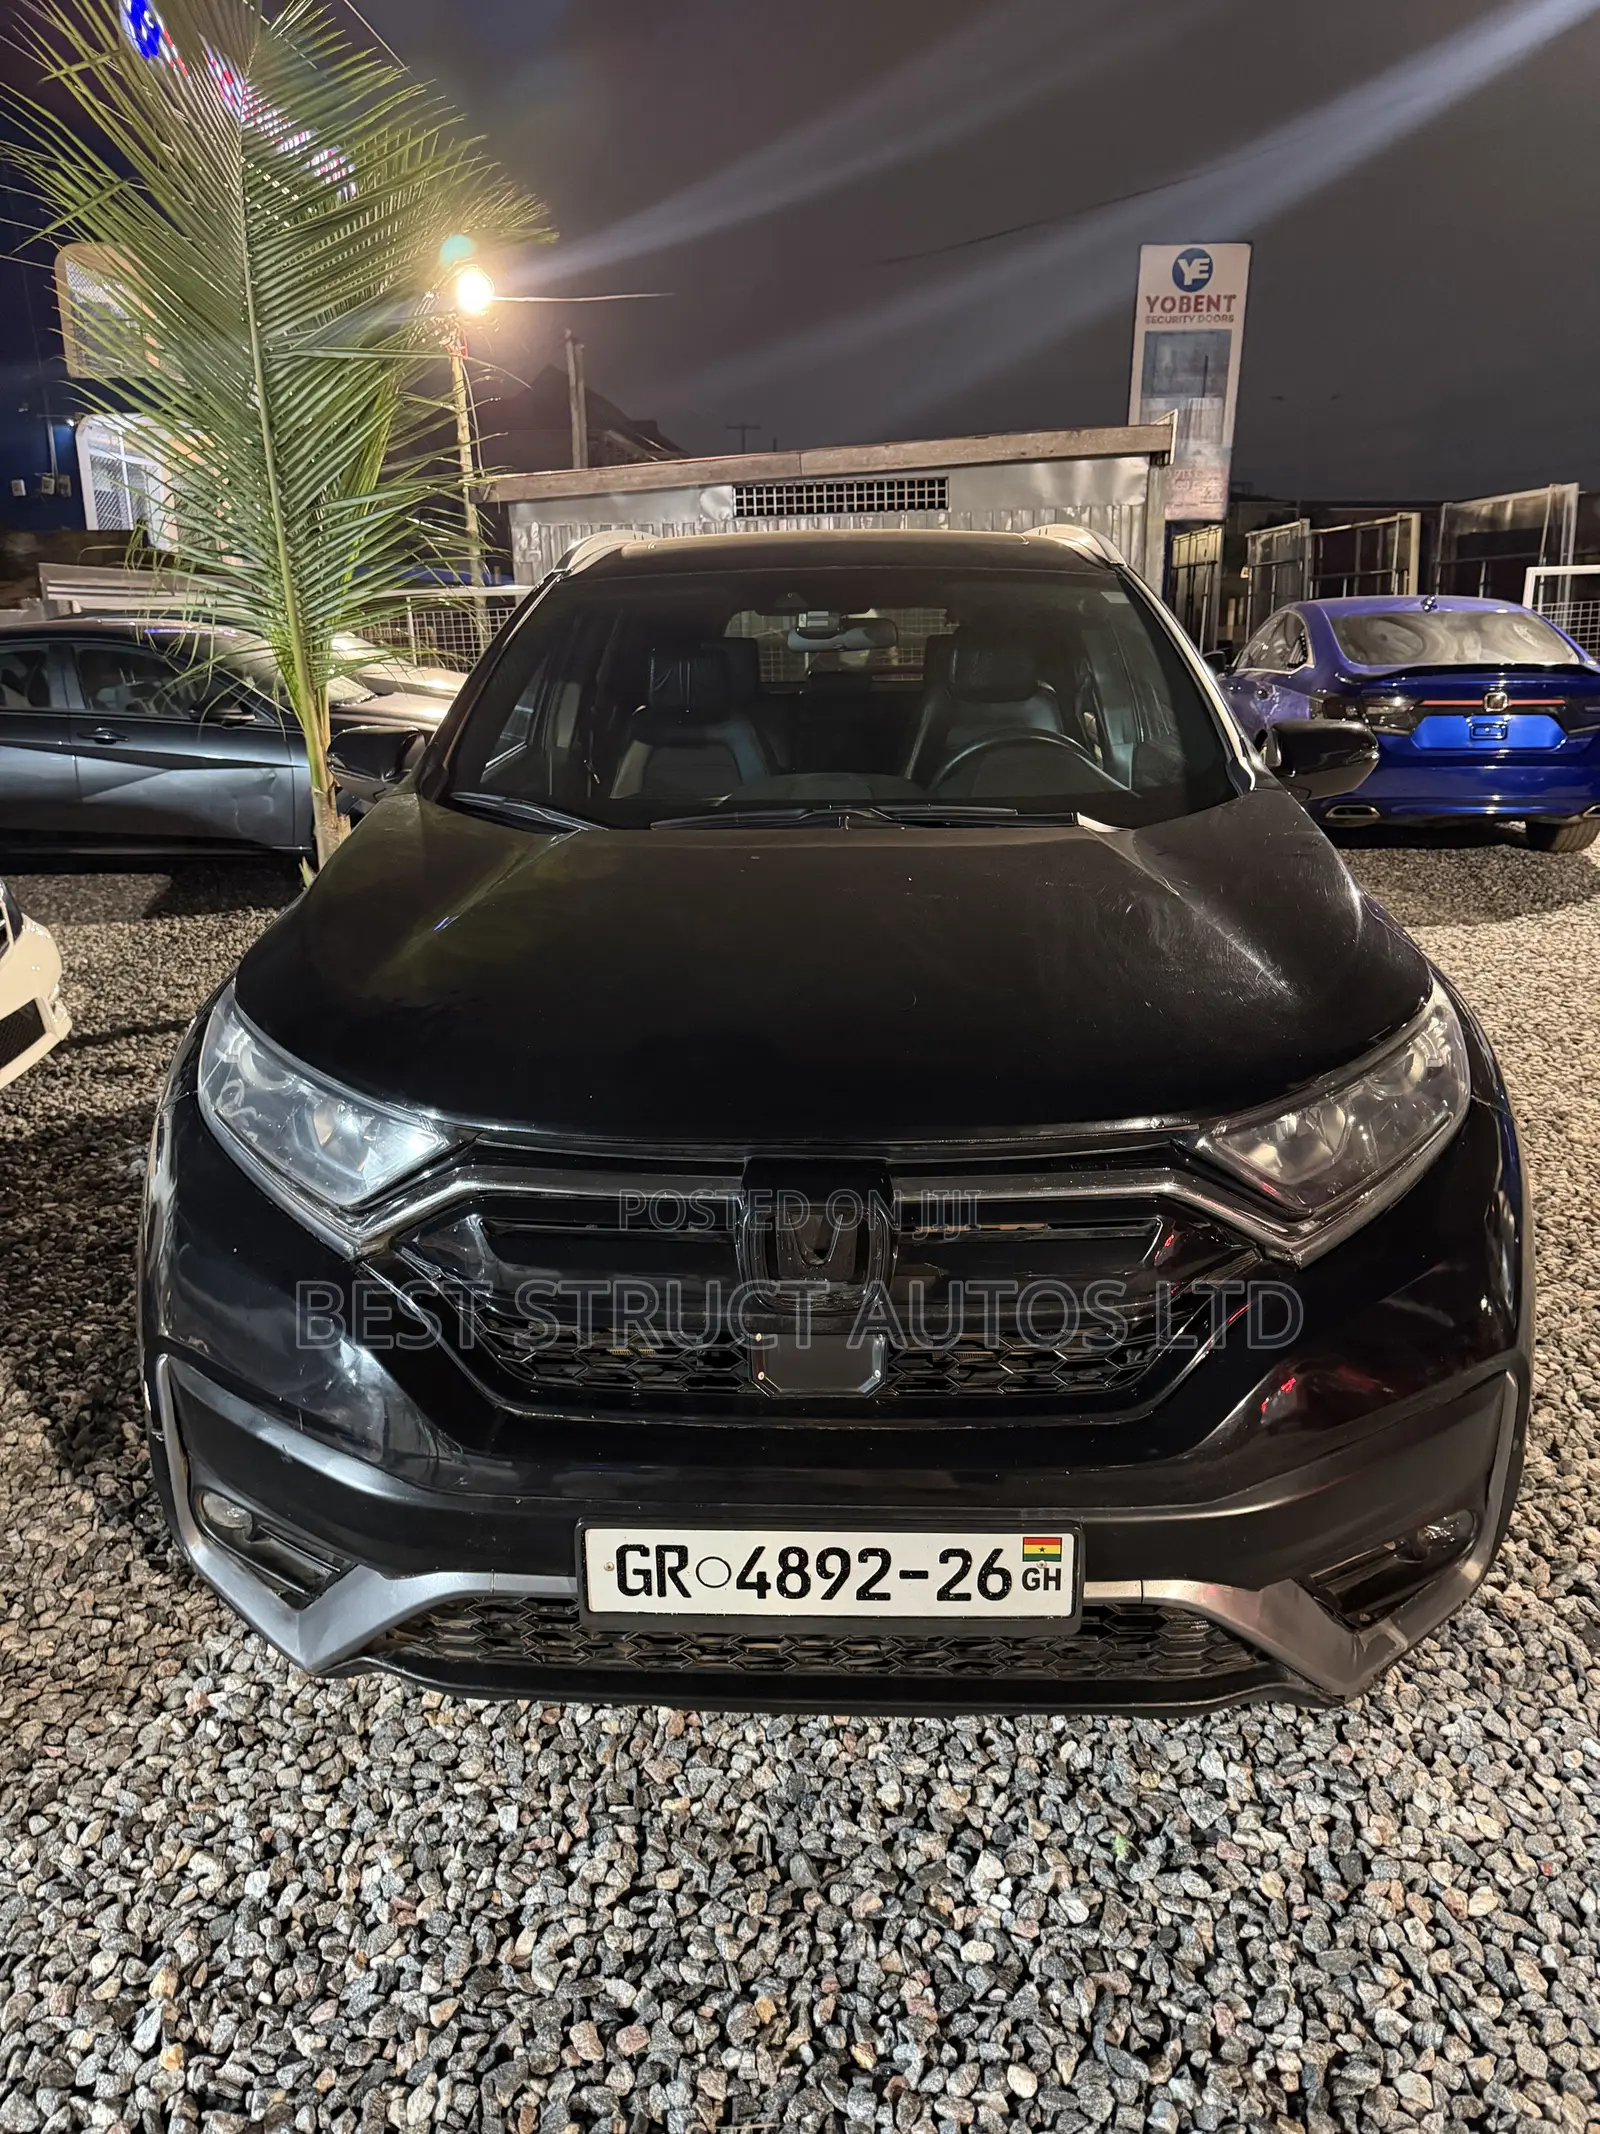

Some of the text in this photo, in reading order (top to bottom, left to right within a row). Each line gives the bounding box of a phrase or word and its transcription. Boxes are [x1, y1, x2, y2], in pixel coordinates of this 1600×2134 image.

[1145, 294, 1237, 314] YOBENT
[1145, 314, 1235, 325] SECURITY DOORS
[735, 1545, 1013, 1602] 4892-26
[1021, 1567, 1062, 1591] GH
